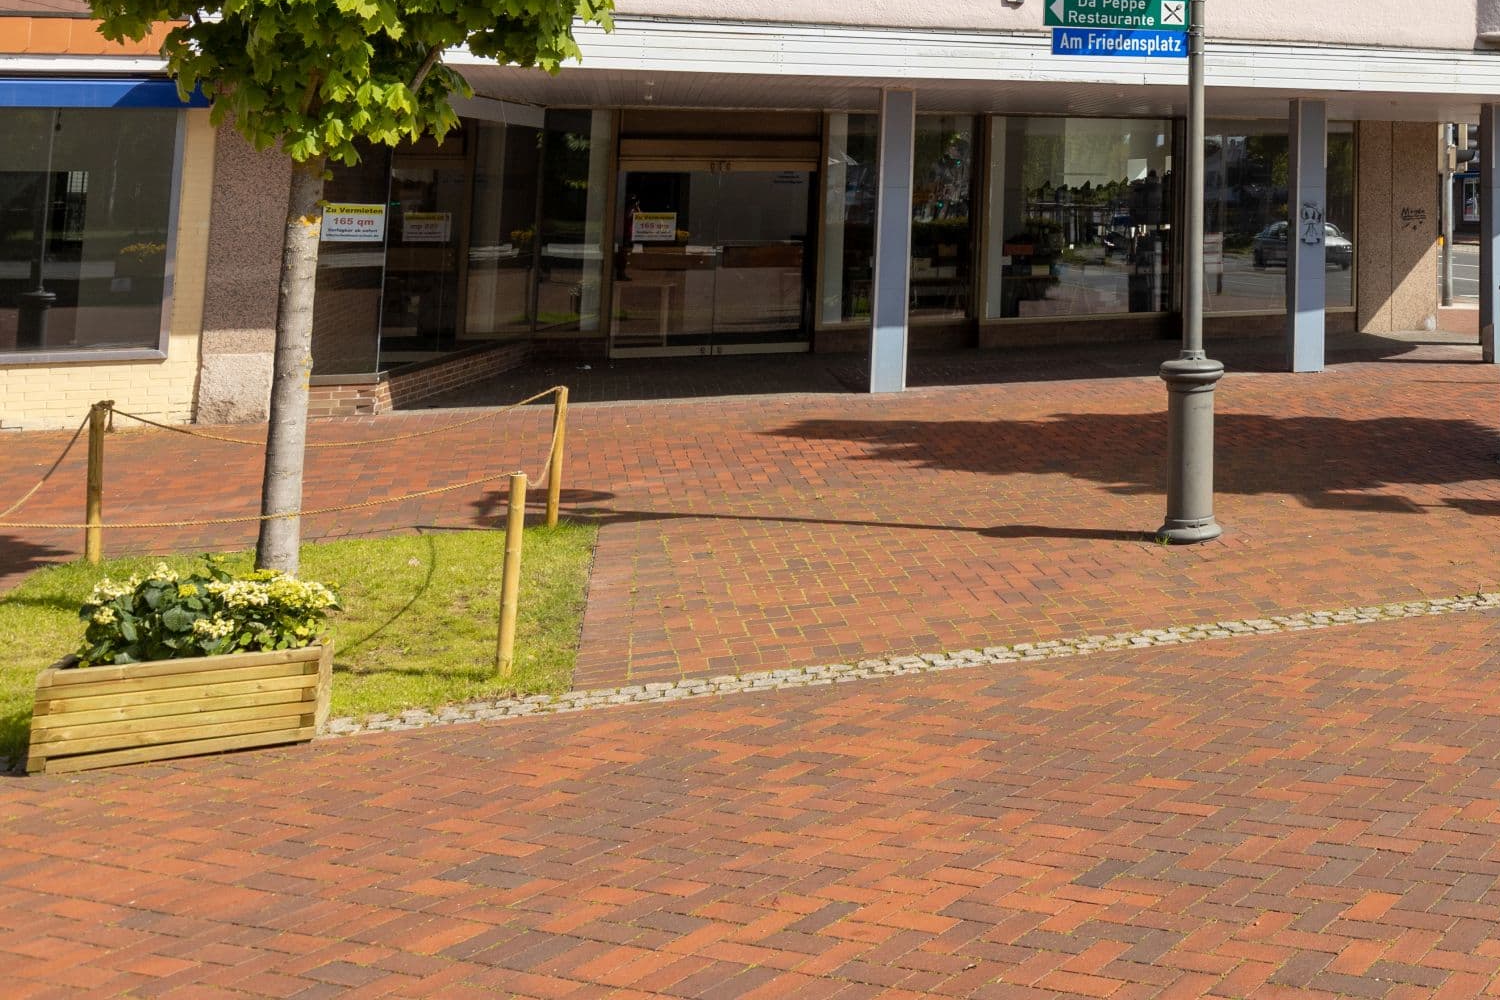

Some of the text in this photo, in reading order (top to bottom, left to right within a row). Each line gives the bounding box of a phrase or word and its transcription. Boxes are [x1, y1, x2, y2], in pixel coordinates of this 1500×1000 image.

[1068, 10, 1155, 26] Restaurante
[1060, 32, 1181, 56] Am Friedensplatz
[339, 207, 384, 215] Vermieten
[333, 217, 375, 227] 165 qm
